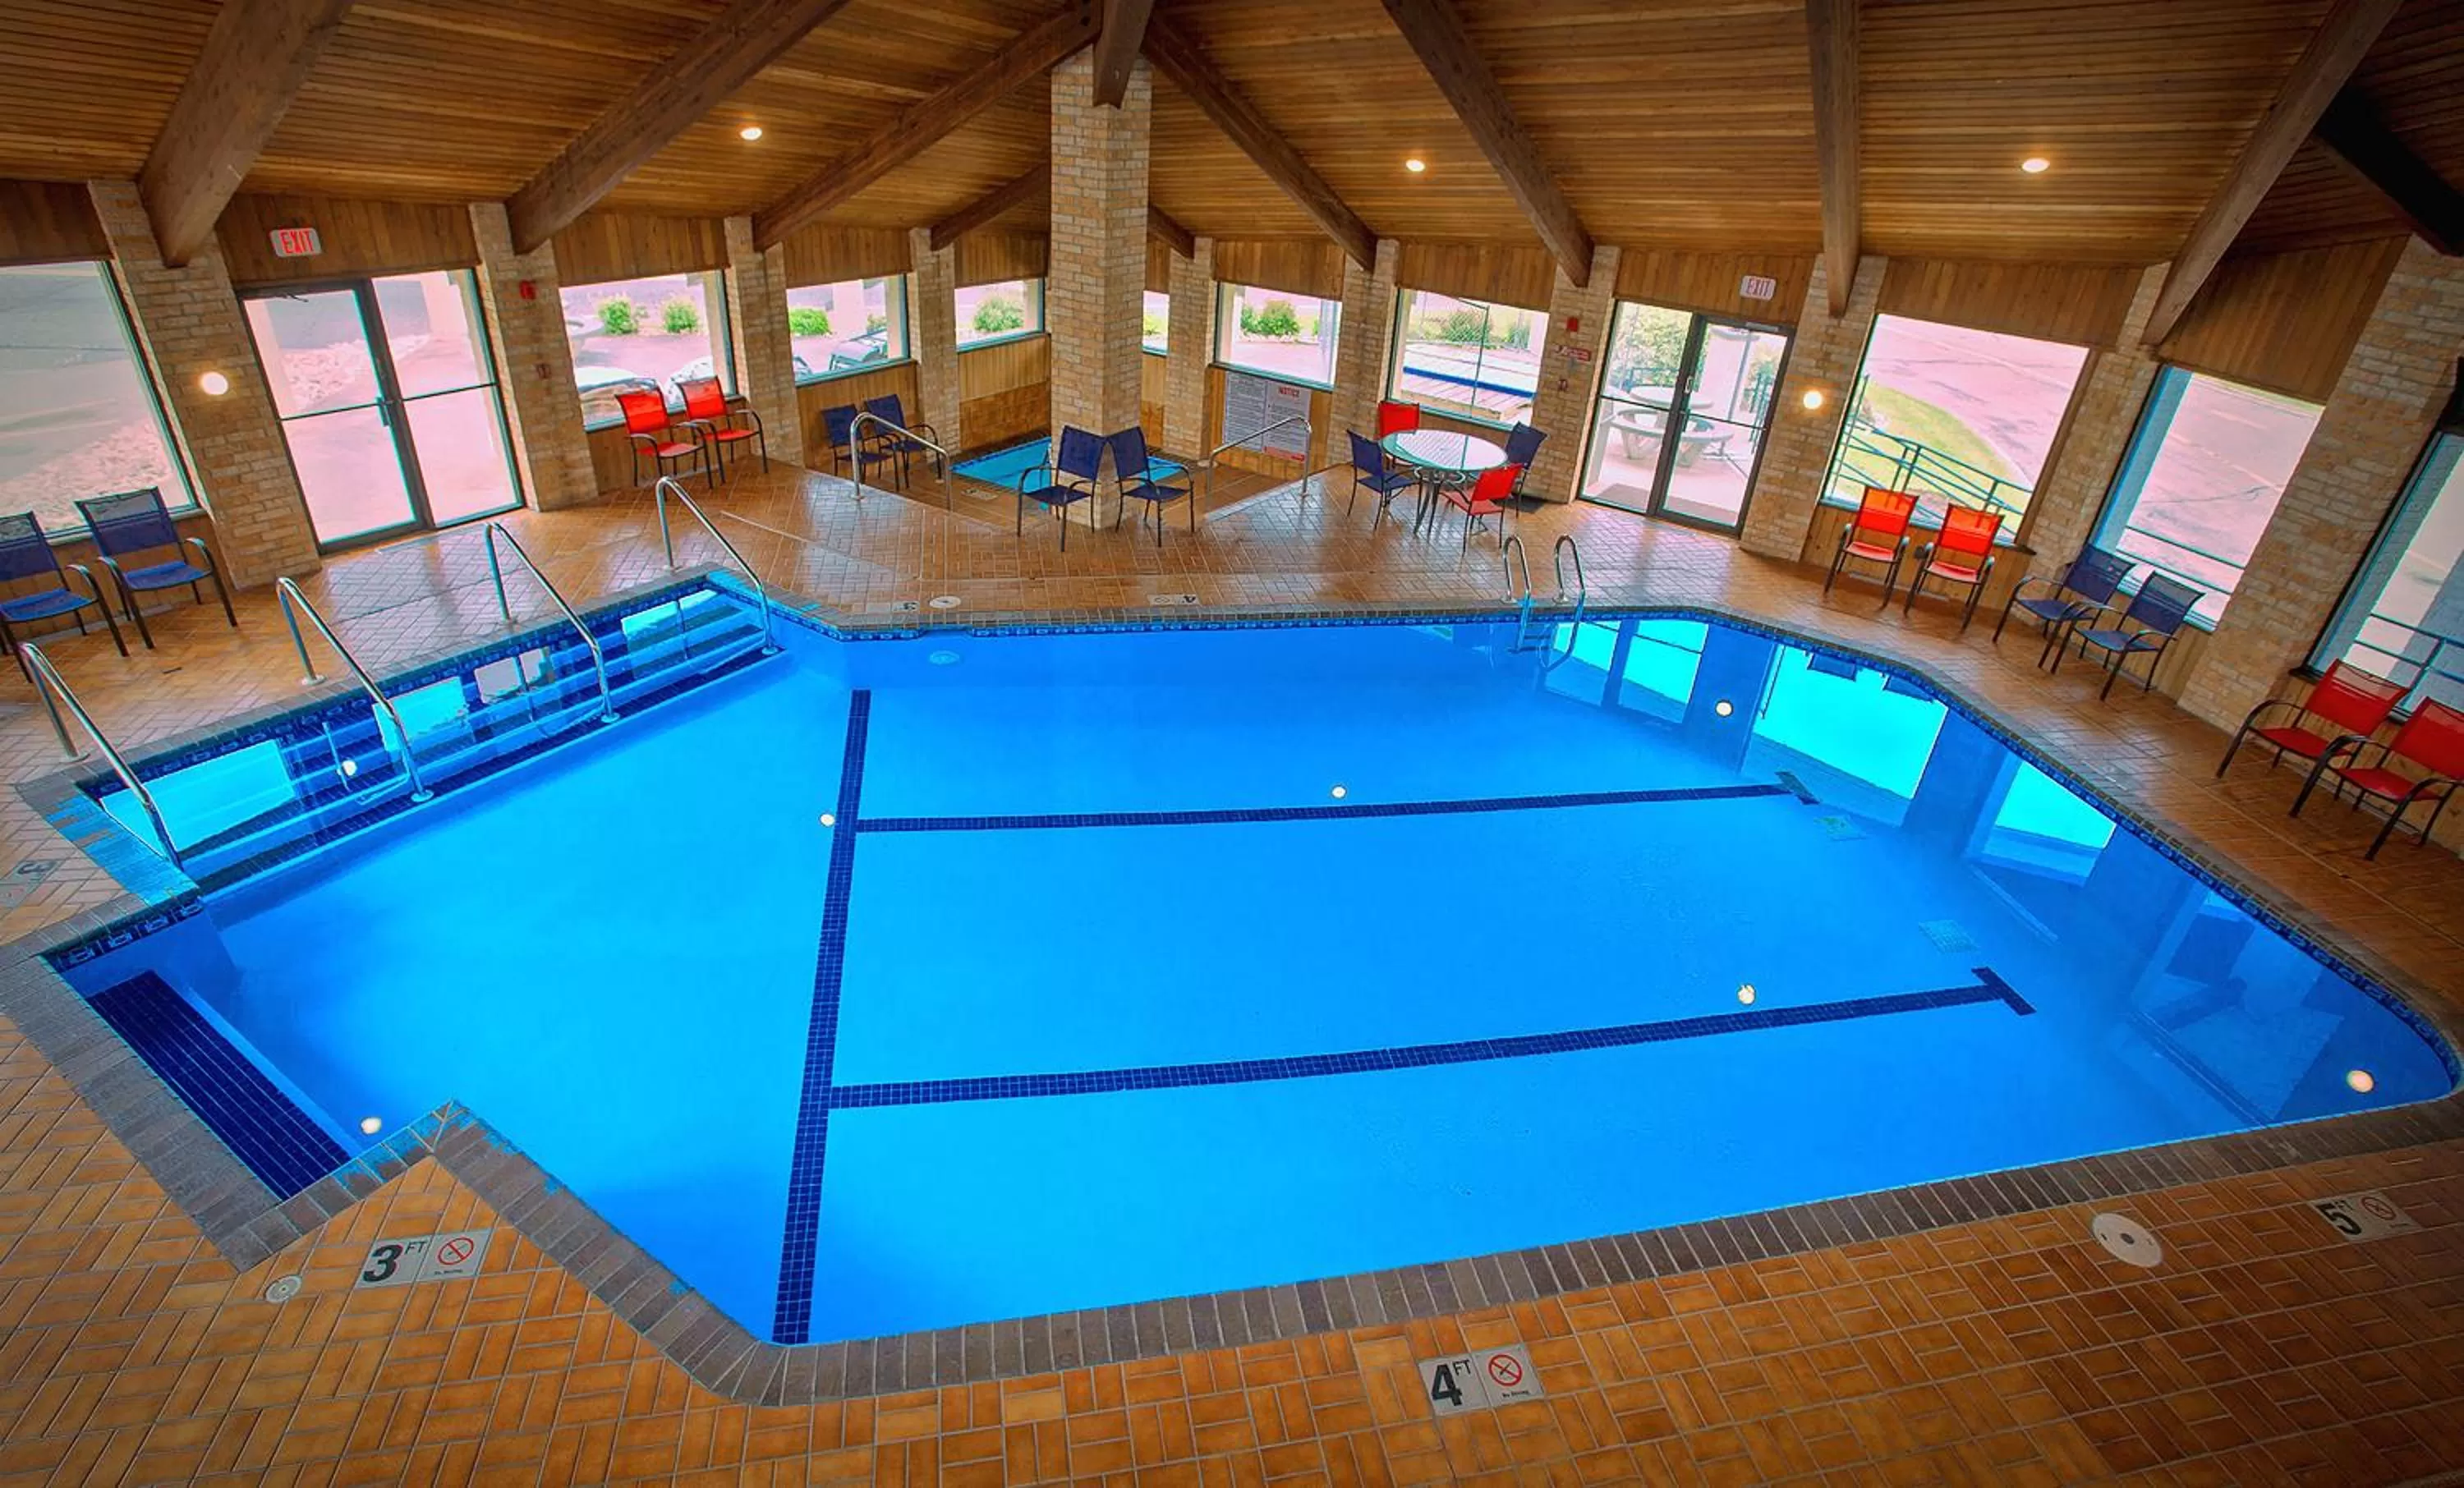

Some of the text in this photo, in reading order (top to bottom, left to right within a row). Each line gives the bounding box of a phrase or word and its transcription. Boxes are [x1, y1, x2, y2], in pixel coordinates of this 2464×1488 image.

[279, 230, 314, 254] EXIT
[1746, 278, 1771, 296] EXIT
[2317, 1203, 2361, 1234] 5
[363, 1241, 426, 1281] 3 FT
[1432, 1359, 1471, 1407] 4 FT
